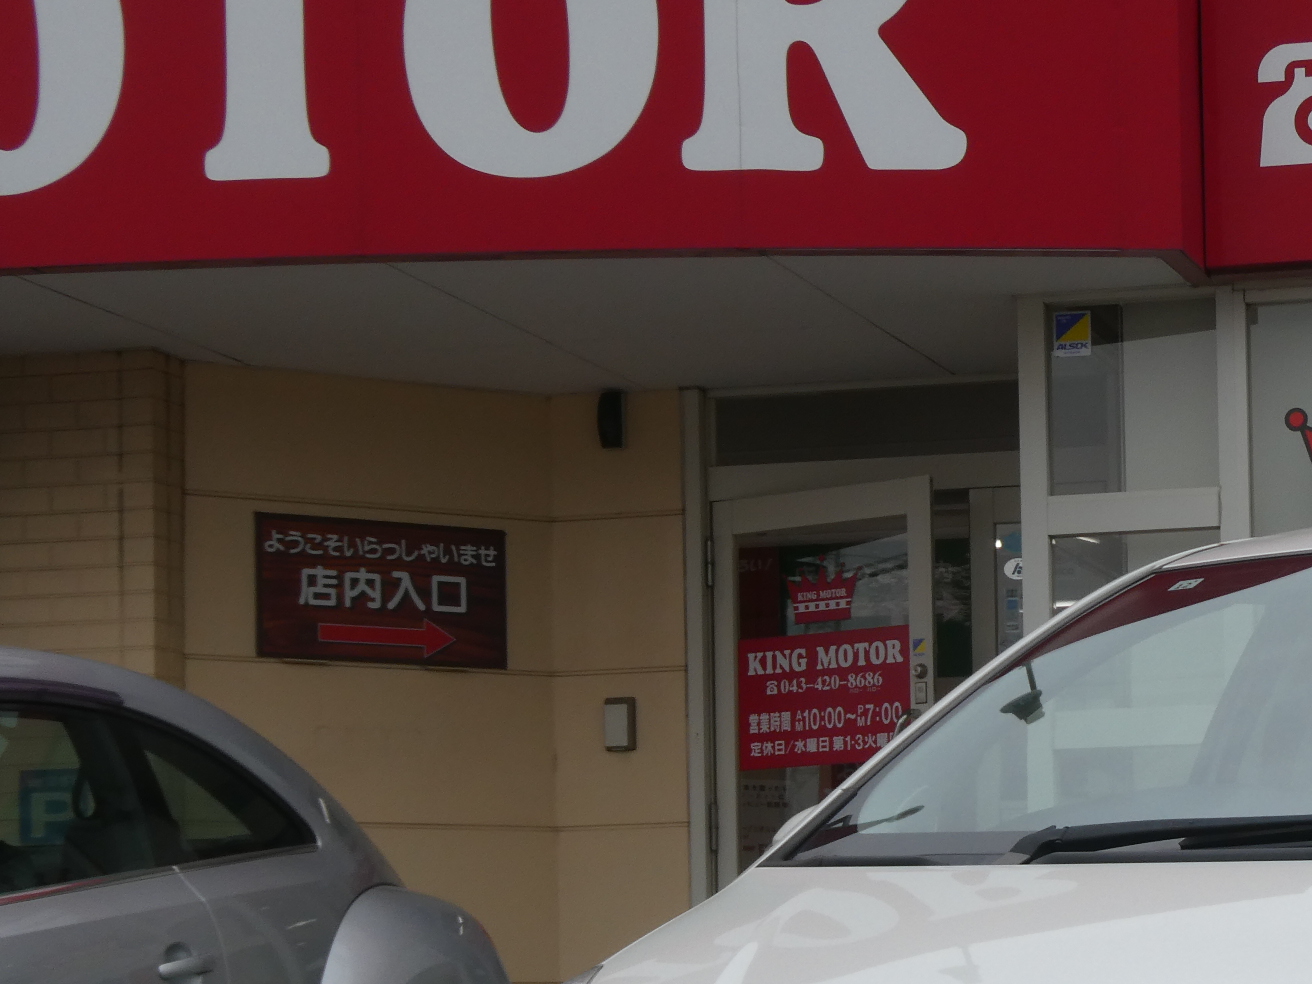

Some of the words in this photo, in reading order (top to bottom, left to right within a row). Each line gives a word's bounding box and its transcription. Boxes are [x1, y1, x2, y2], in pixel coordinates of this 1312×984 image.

[1056, 342, 1090, 350] ALSOK
[299, 566, 467, 613] 店内入口
[797, 591, 817, 601] KING
[819, 588, 847, 598] MOTOR
[747, 649, 808, 675] KING
[816, 639, 904, 670] MOTOR
[781, 671, 883, 694] 043-420-8686
[749, 711, 791, 734] 営業時間
